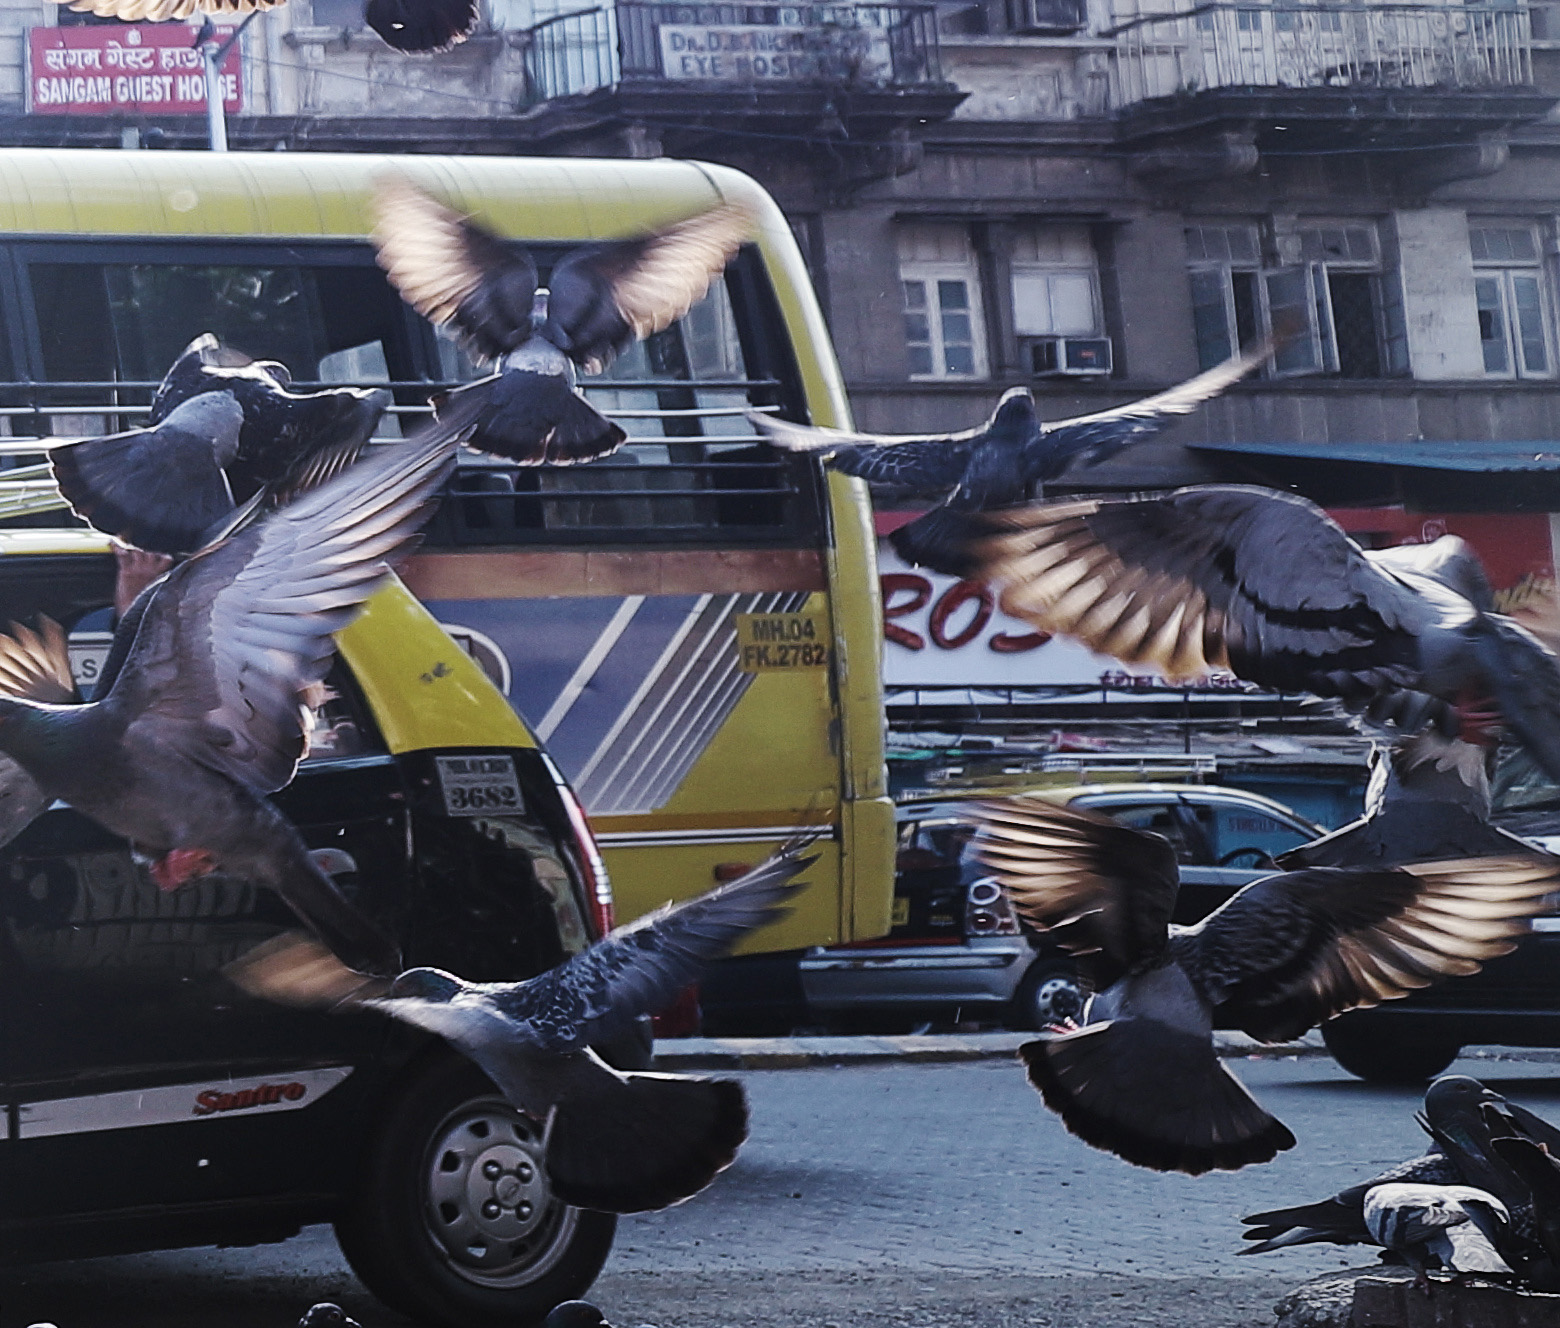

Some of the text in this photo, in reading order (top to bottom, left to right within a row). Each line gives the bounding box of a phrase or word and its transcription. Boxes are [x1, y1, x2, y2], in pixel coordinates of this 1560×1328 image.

[45, 41, 102, 70] संगम
[106, 40, 155, 69] गेस्ट
[38, 76, 112, 104] SANGAM
[116, 75, 172, 102] GUEST
[192, 1082, 307, 1116] Santro
